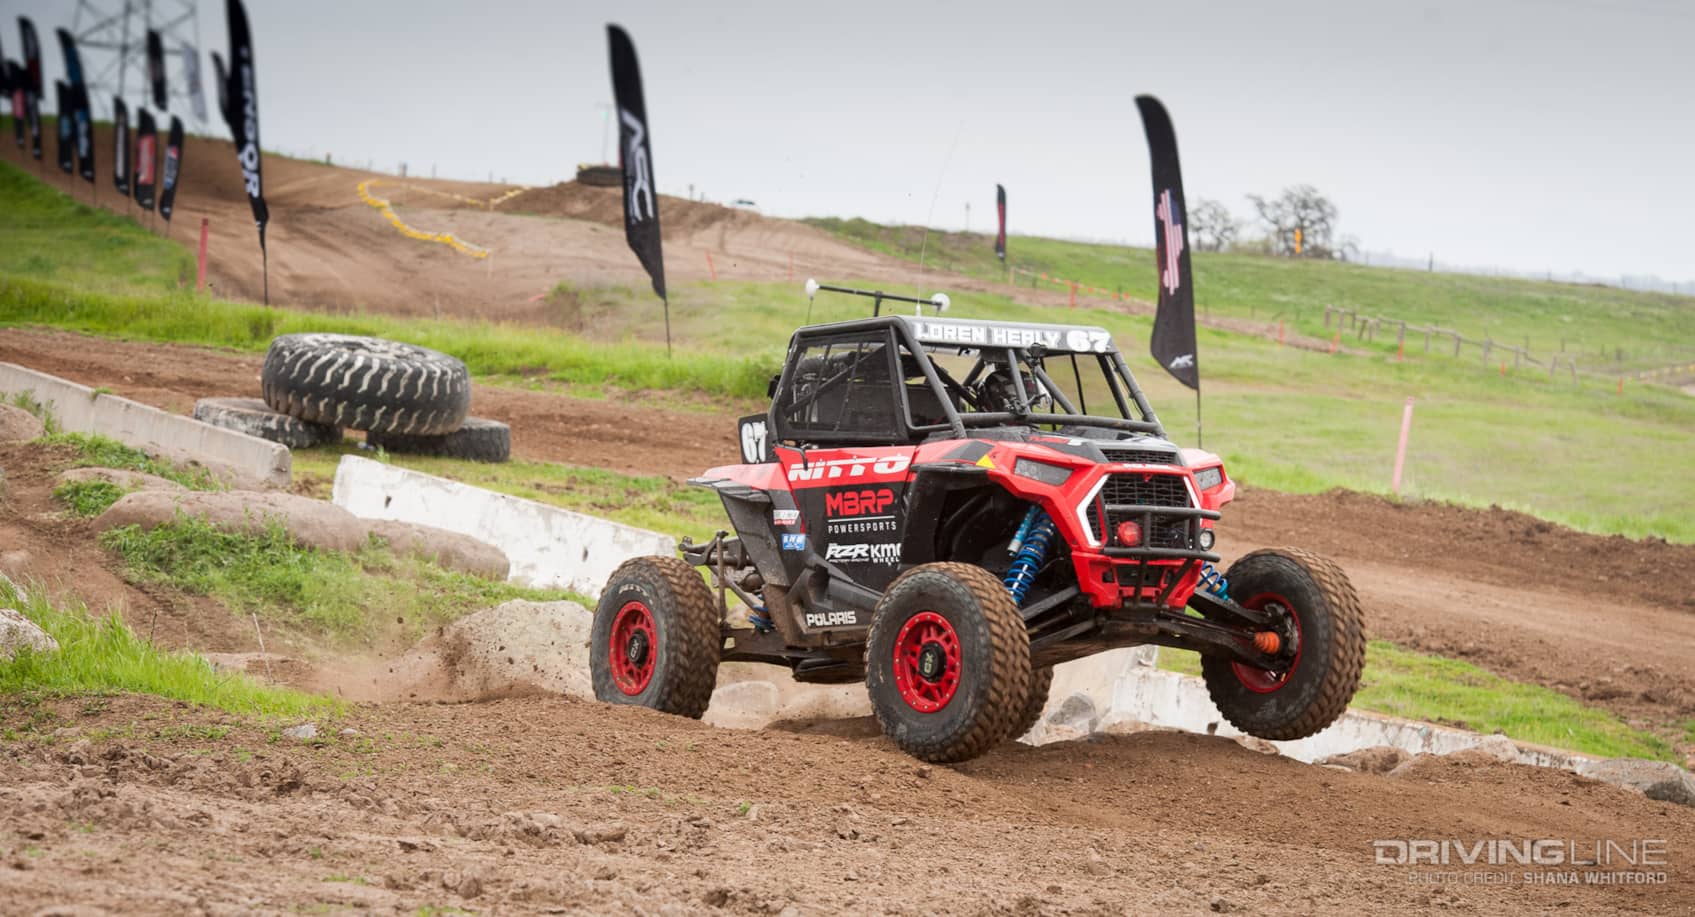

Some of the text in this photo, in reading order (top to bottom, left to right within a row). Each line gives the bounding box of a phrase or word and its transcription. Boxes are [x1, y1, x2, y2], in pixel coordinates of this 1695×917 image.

[915, 323, 1111, 353] LOREN HEALY 67
[742, 422, 767, 462] 67
[789, 456, 911, 481] NITTO
[826, 489, 894, 518] MBRP
[828, 522, 896, 534] POWERSPORTS
[806, 611, 857, 626] POLARIS
